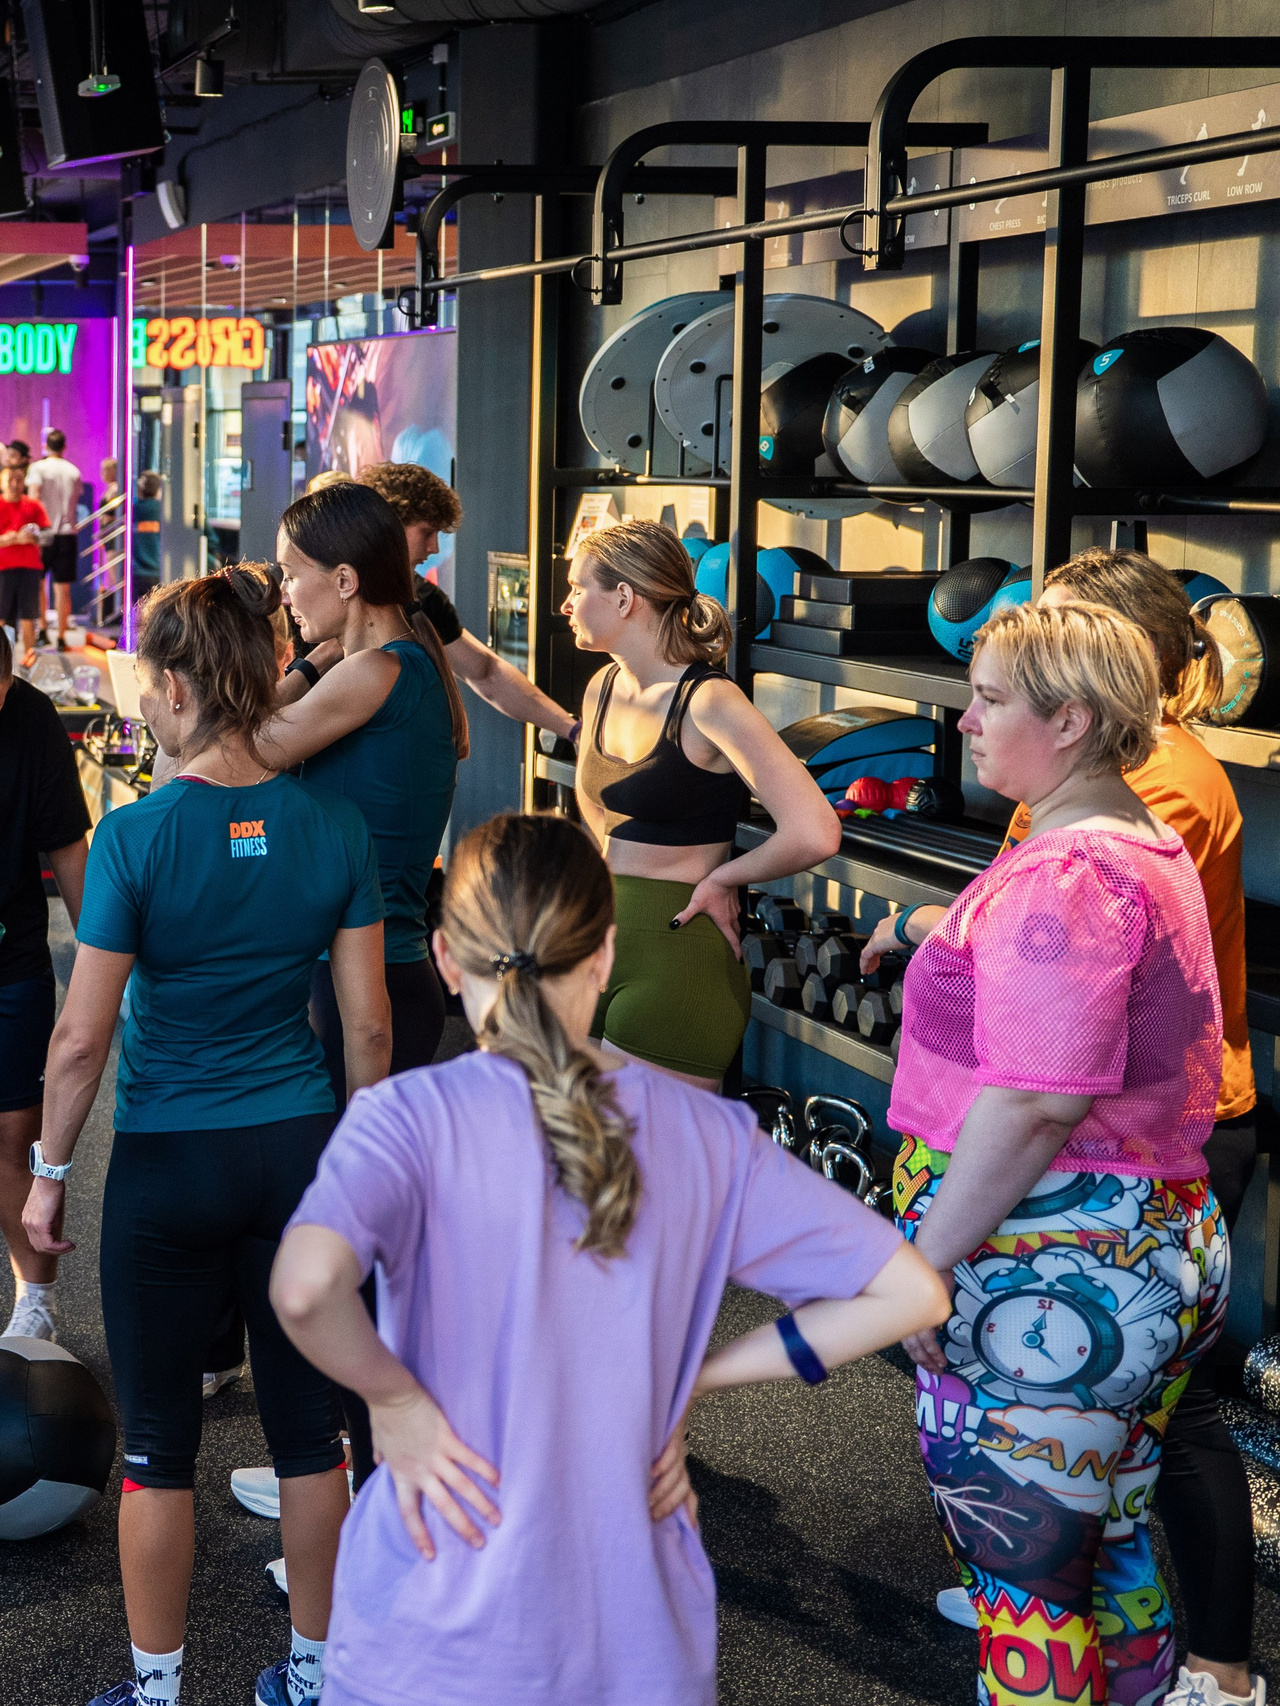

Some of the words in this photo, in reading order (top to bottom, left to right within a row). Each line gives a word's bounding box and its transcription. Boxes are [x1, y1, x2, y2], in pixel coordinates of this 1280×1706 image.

[1167, 193, 1192, 206] TRICEPS
[1194, 190, 1211, 202] CURL
[1227, 185, 1243, 197] LOW
[1245, 182, 1263, 194] ROW
[229, 820, 266, 838] DDX
[230, 837, 268, 858] FITNESS
